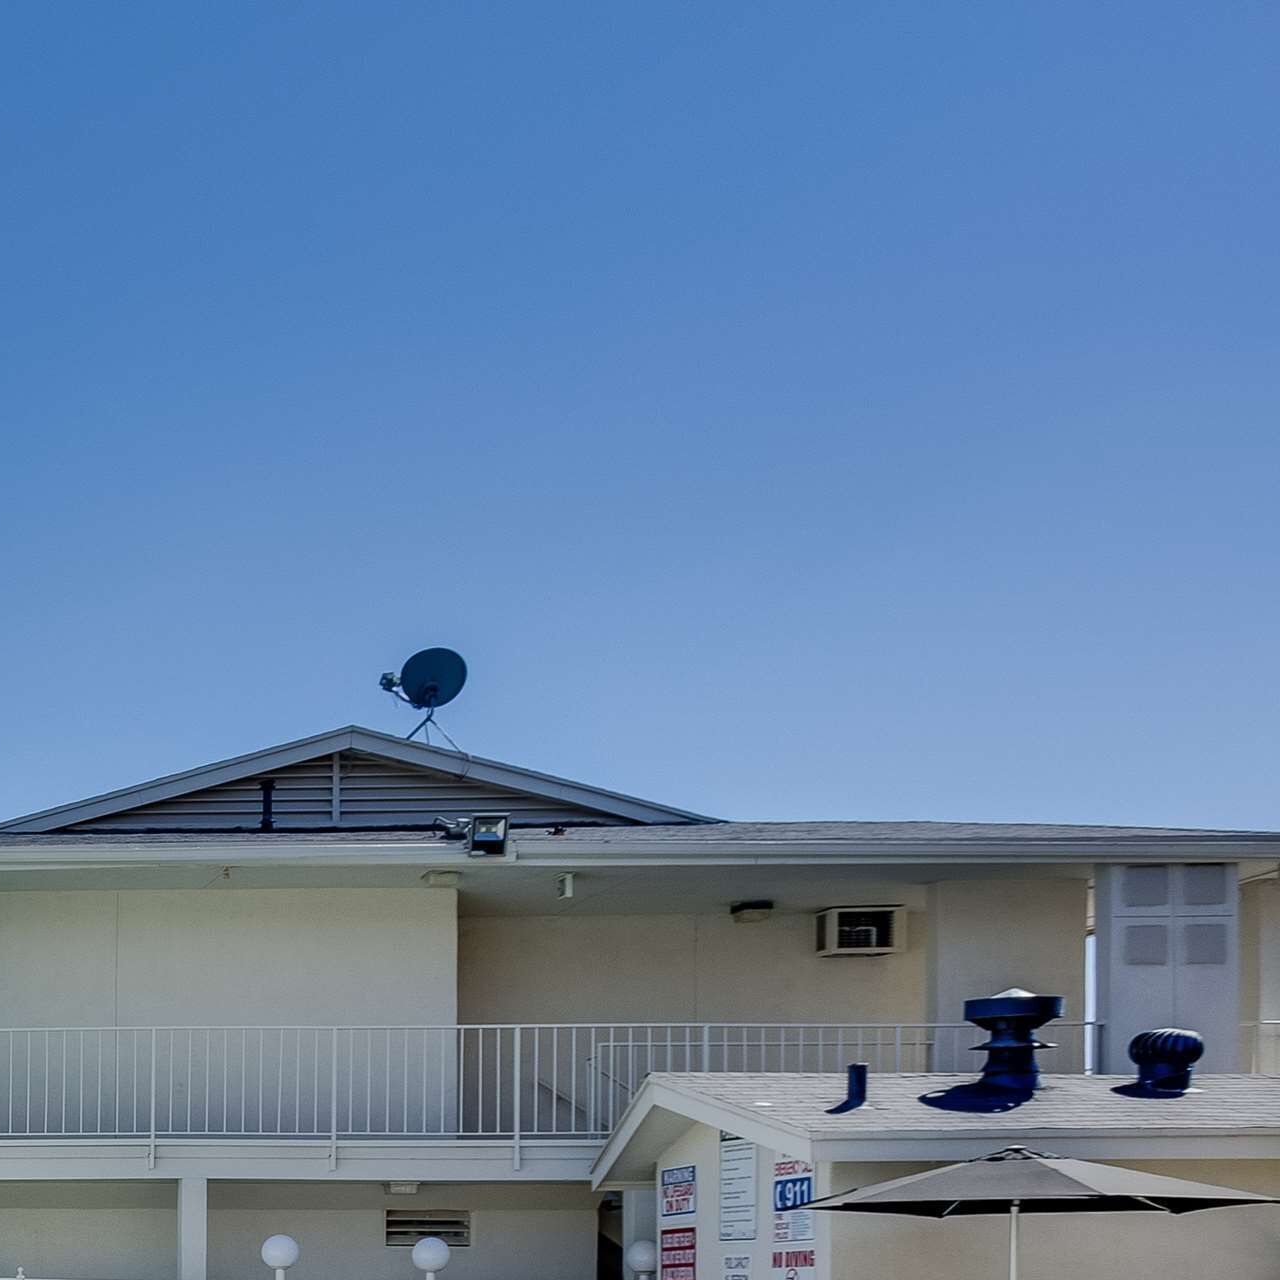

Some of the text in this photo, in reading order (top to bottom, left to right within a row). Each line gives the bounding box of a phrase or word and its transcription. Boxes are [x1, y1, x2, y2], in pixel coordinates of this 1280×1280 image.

[785, 1180, 809, 1206] 911
[772, 1250, 816, 1268] NO DIVING
